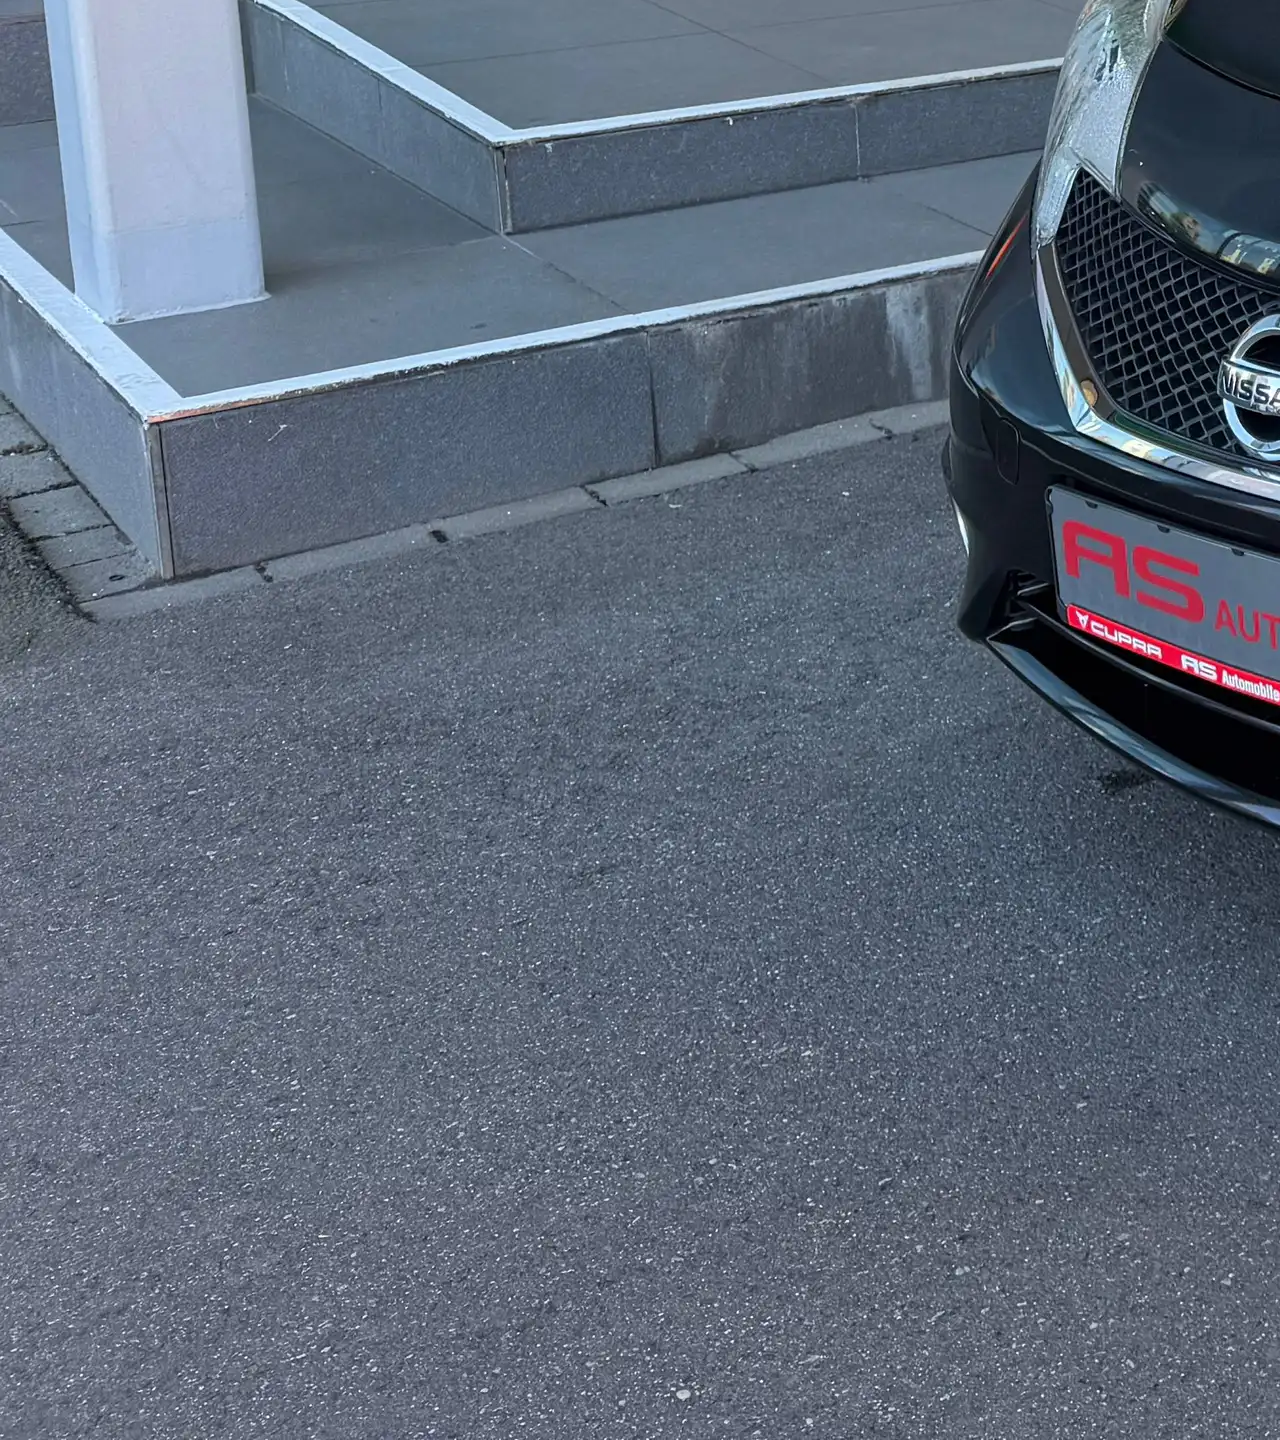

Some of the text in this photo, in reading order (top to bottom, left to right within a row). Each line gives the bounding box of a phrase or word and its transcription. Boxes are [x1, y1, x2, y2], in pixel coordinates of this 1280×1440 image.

[1062, 519, 1206, 624] AS
[1089, 621, 1164, 661] CUPRA
[1180, 653, 1218, 681] AS
[1221, 670, 1280, 703] Automobile
